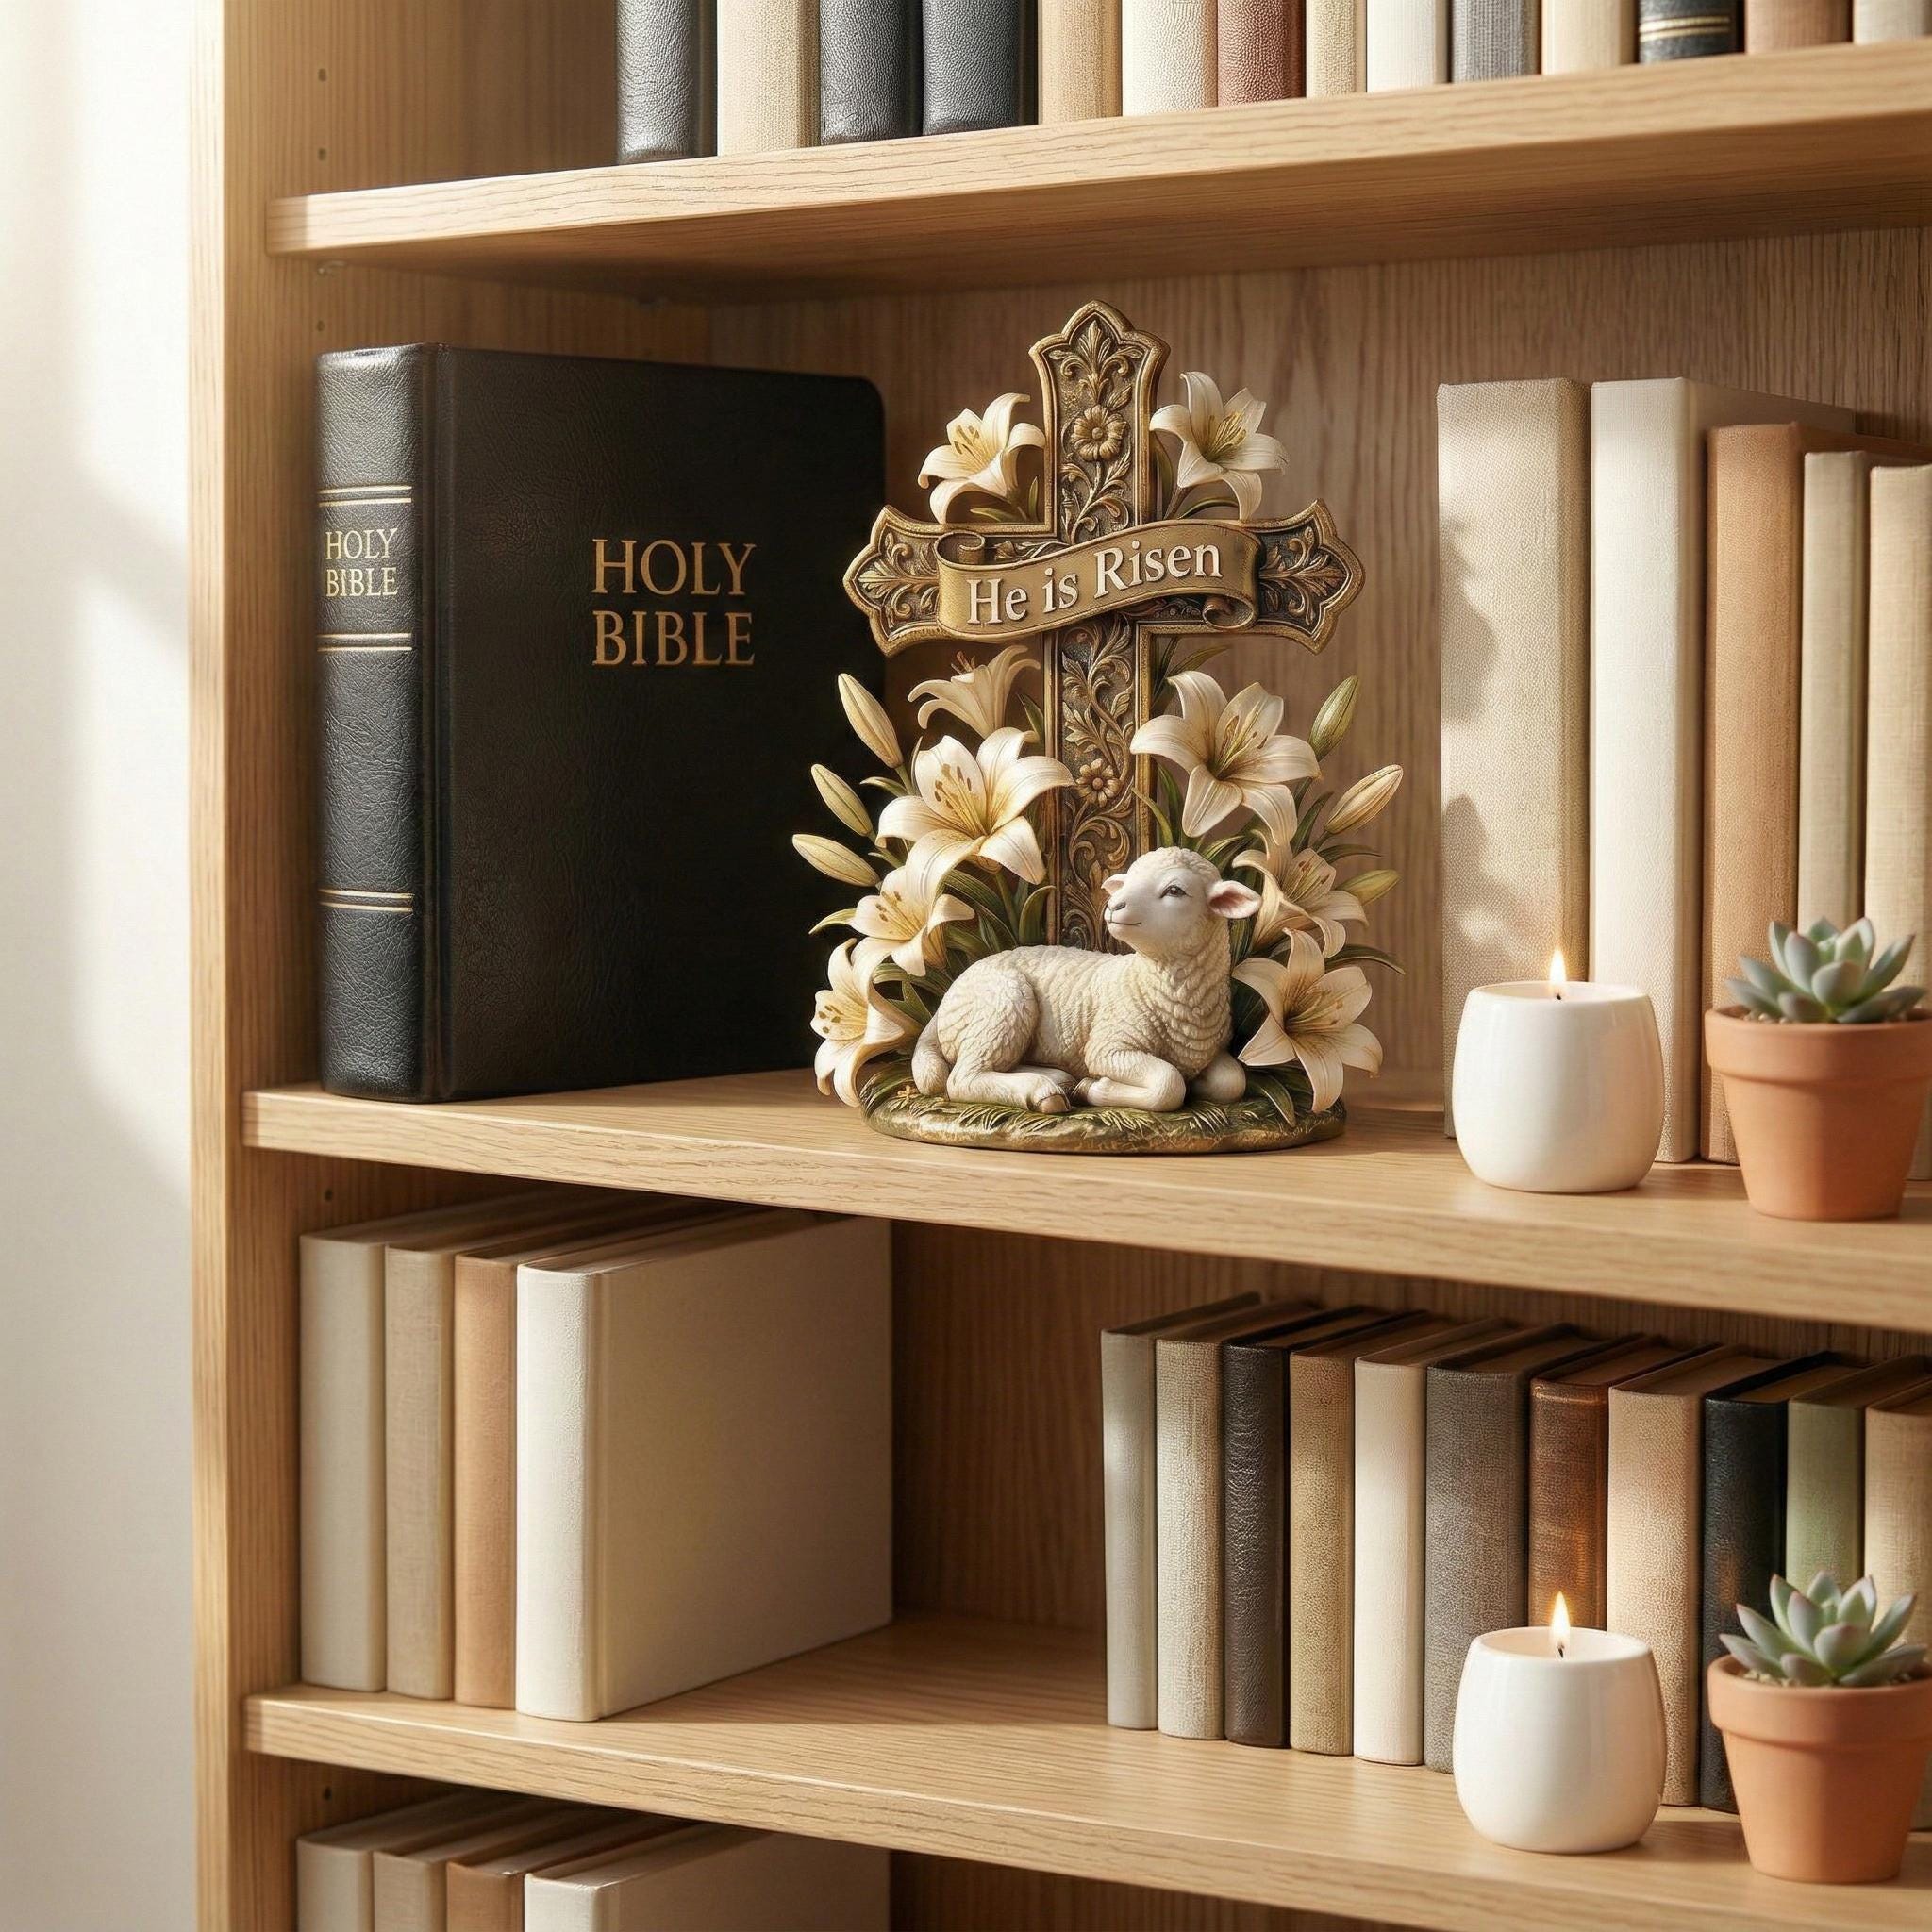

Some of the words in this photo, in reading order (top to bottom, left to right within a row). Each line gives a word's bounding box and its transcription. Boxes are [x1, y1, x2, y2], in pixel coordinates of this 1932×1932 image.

[325, 527, 398, 560] HOLY
[591, 538, 757, 596] HOLY
[325, 566, 398, 598] BIBLE
[966, 578, 1028, 625] He
[1042, 568, 1079, 613] is
[1093, 540, 1224, 599] Risen
[591, 610, 756, 666] BIBLE
